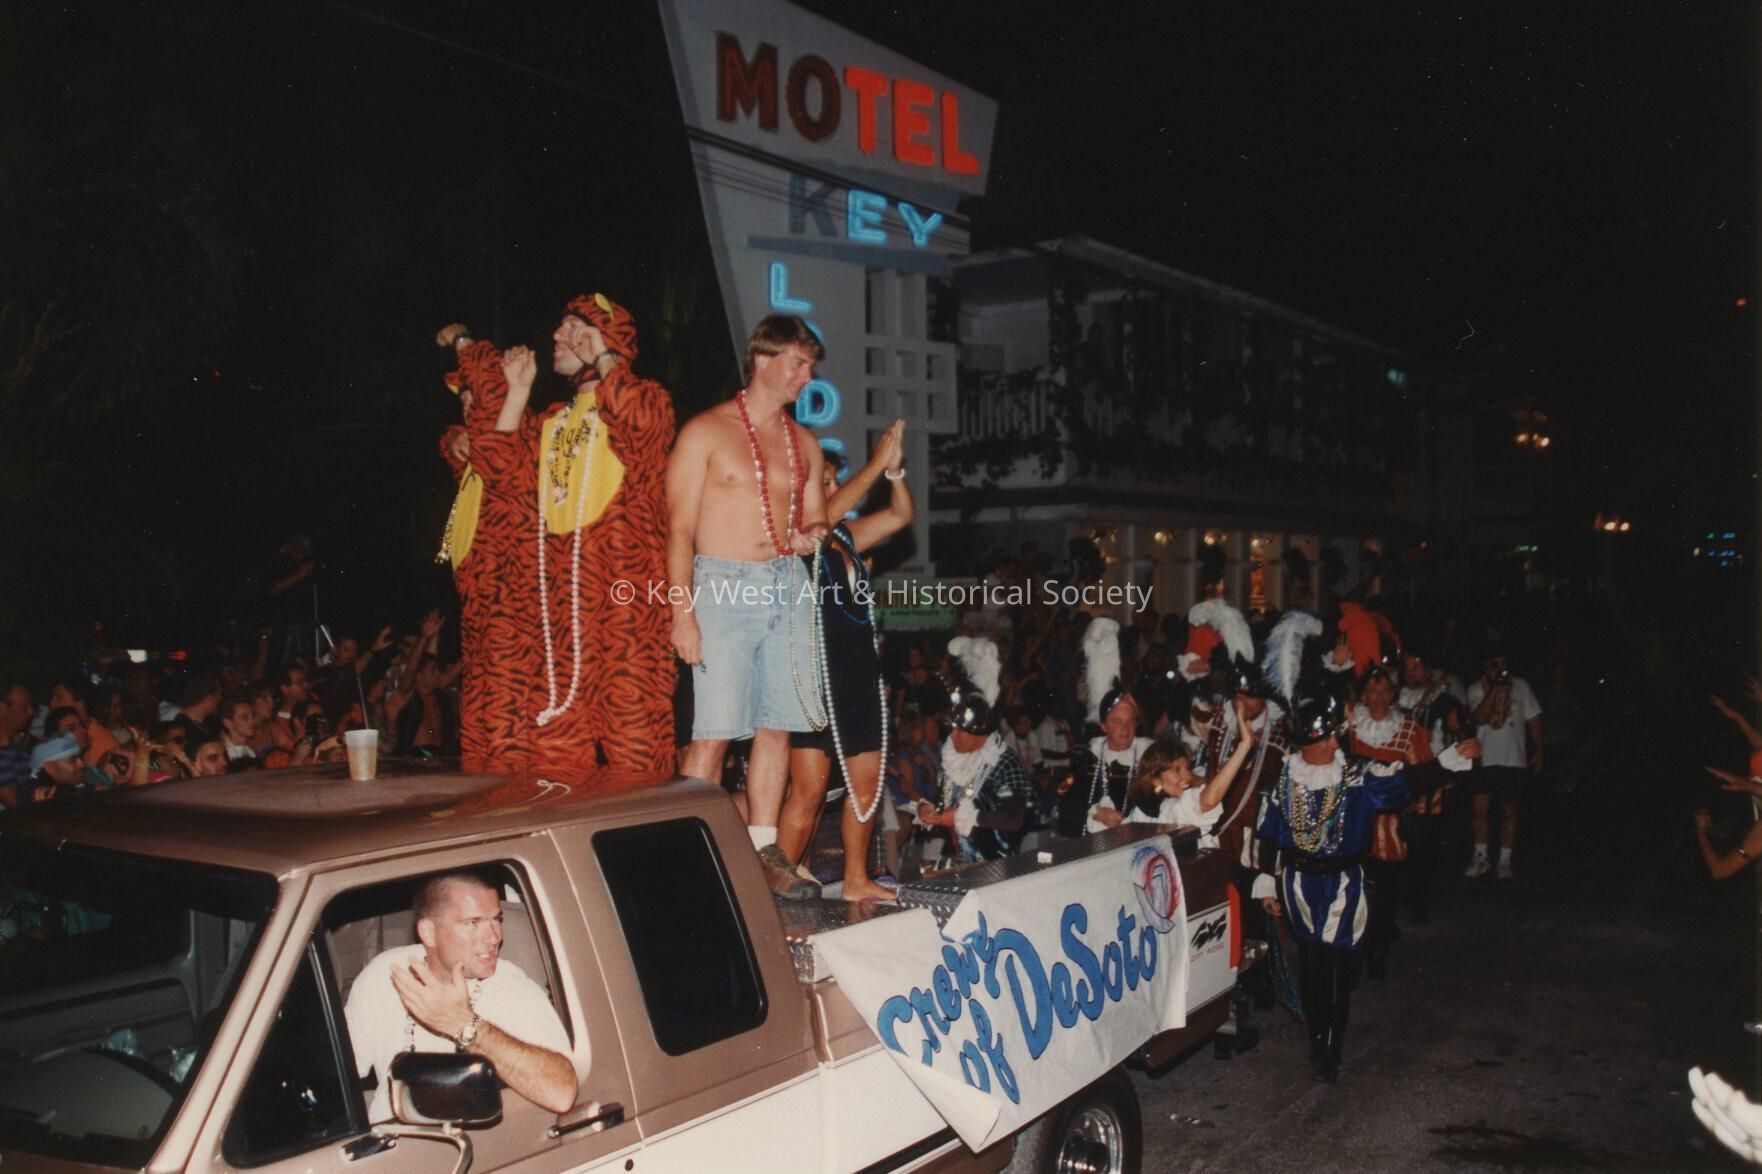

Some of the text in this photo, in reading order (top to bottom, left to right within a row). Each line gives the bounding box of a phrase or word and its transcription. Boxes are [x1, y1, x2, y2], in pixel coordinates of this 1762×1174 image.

[715, 31, 980, 177] MOTEL
[788, 173, 943, 247] KEY
[960, 903, 1158, 1104] of DeSoto
